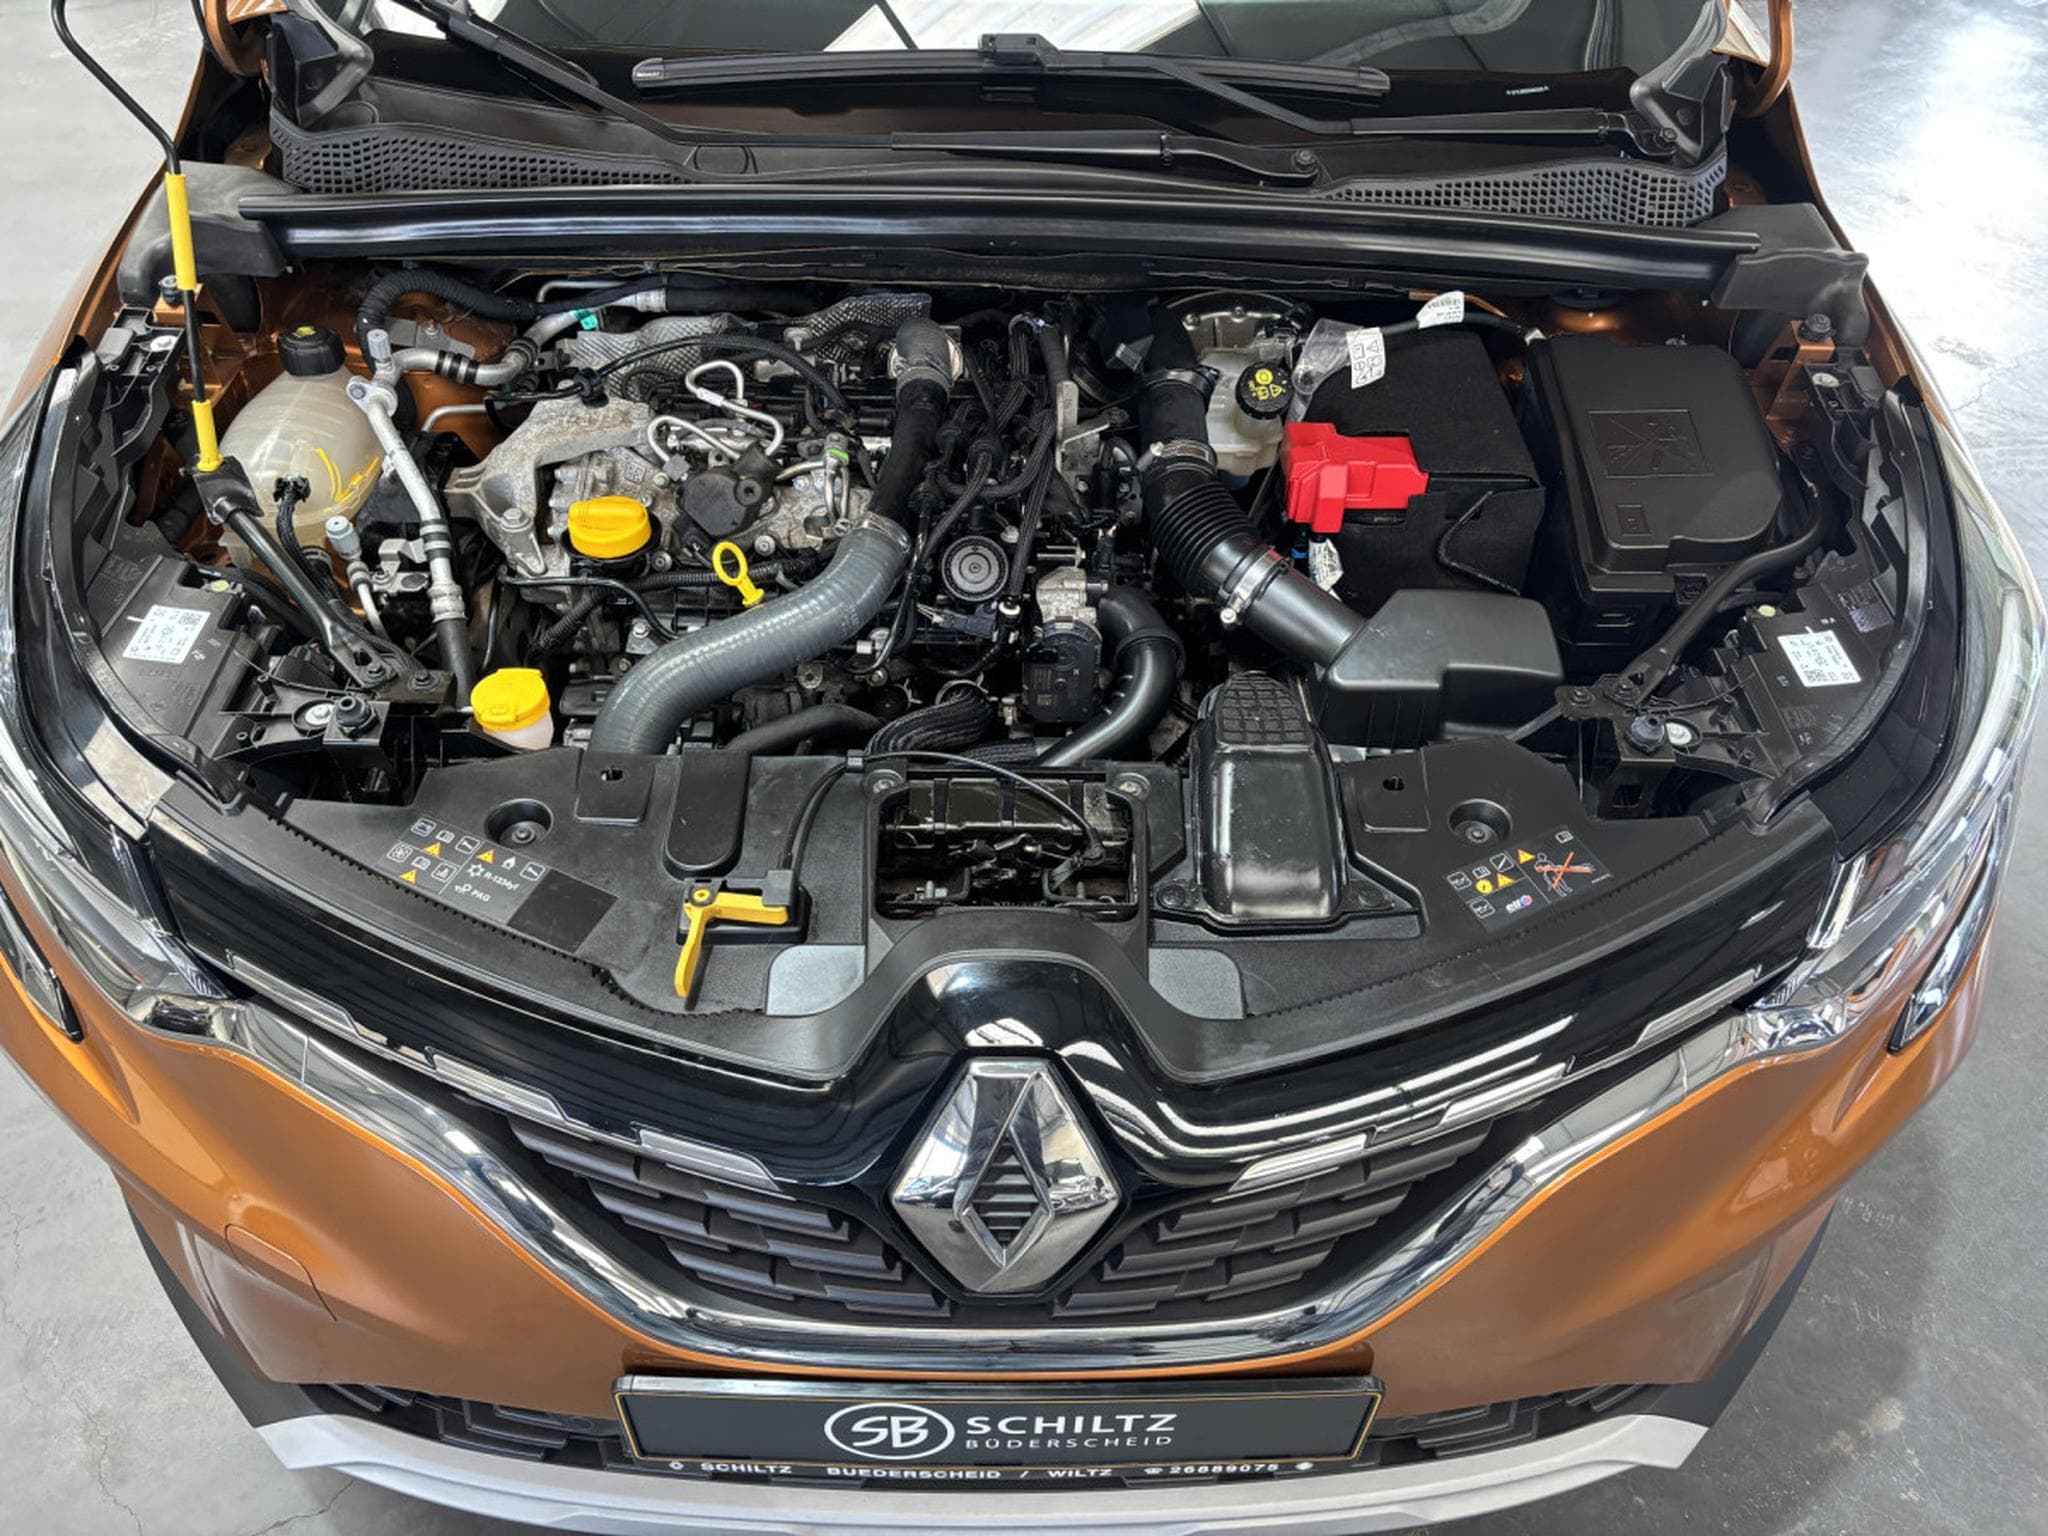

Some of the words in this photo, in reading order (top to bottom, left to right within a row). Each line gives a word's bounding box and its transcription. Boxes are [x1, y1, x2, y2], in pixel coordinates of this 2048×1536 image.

[471, 889, 491, 902] PAG
[851, 1416, 929, 1448] SB
[966, 1413, 1178, 1435] SCHILTZ
[965, 1437, 1173, 1449] BÜDERSCHEID
[700, 1462, 793, 1474] SCHILTZ
[826, 1467, 1001, 1479] BUEDERSCHEID
[1048, 1469, 1113, 1478] WILTZ
